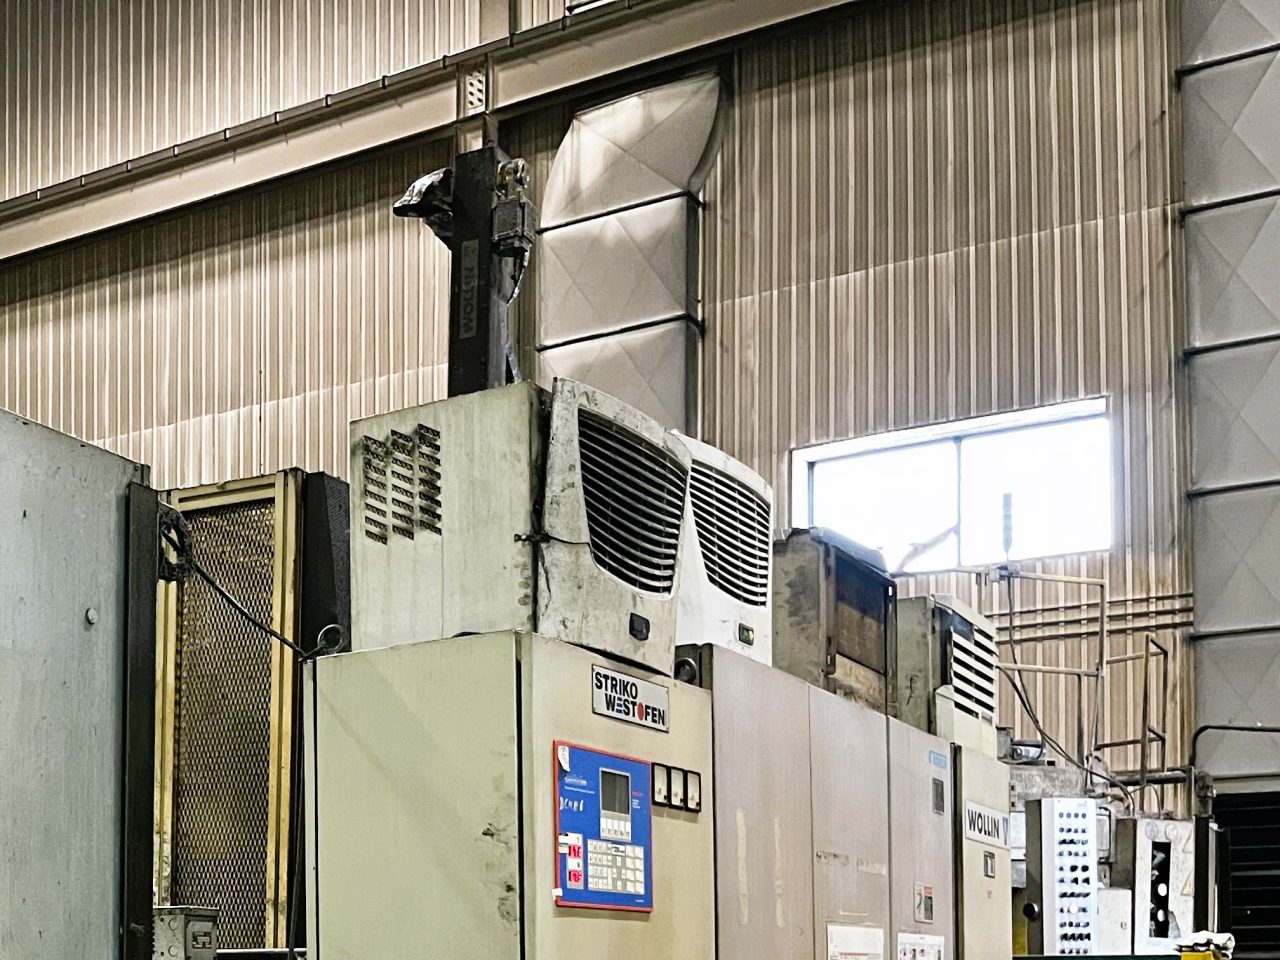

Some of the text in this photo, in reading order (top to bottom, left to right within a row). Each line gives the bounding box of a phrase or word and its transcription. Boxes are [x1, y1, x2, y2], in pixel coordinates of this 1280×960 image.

[595, 672, 638, 699] STRIKO
[604, 693, 665, 726] WESTOFEN
[967, 808, 1000, 839] WOLLIN
